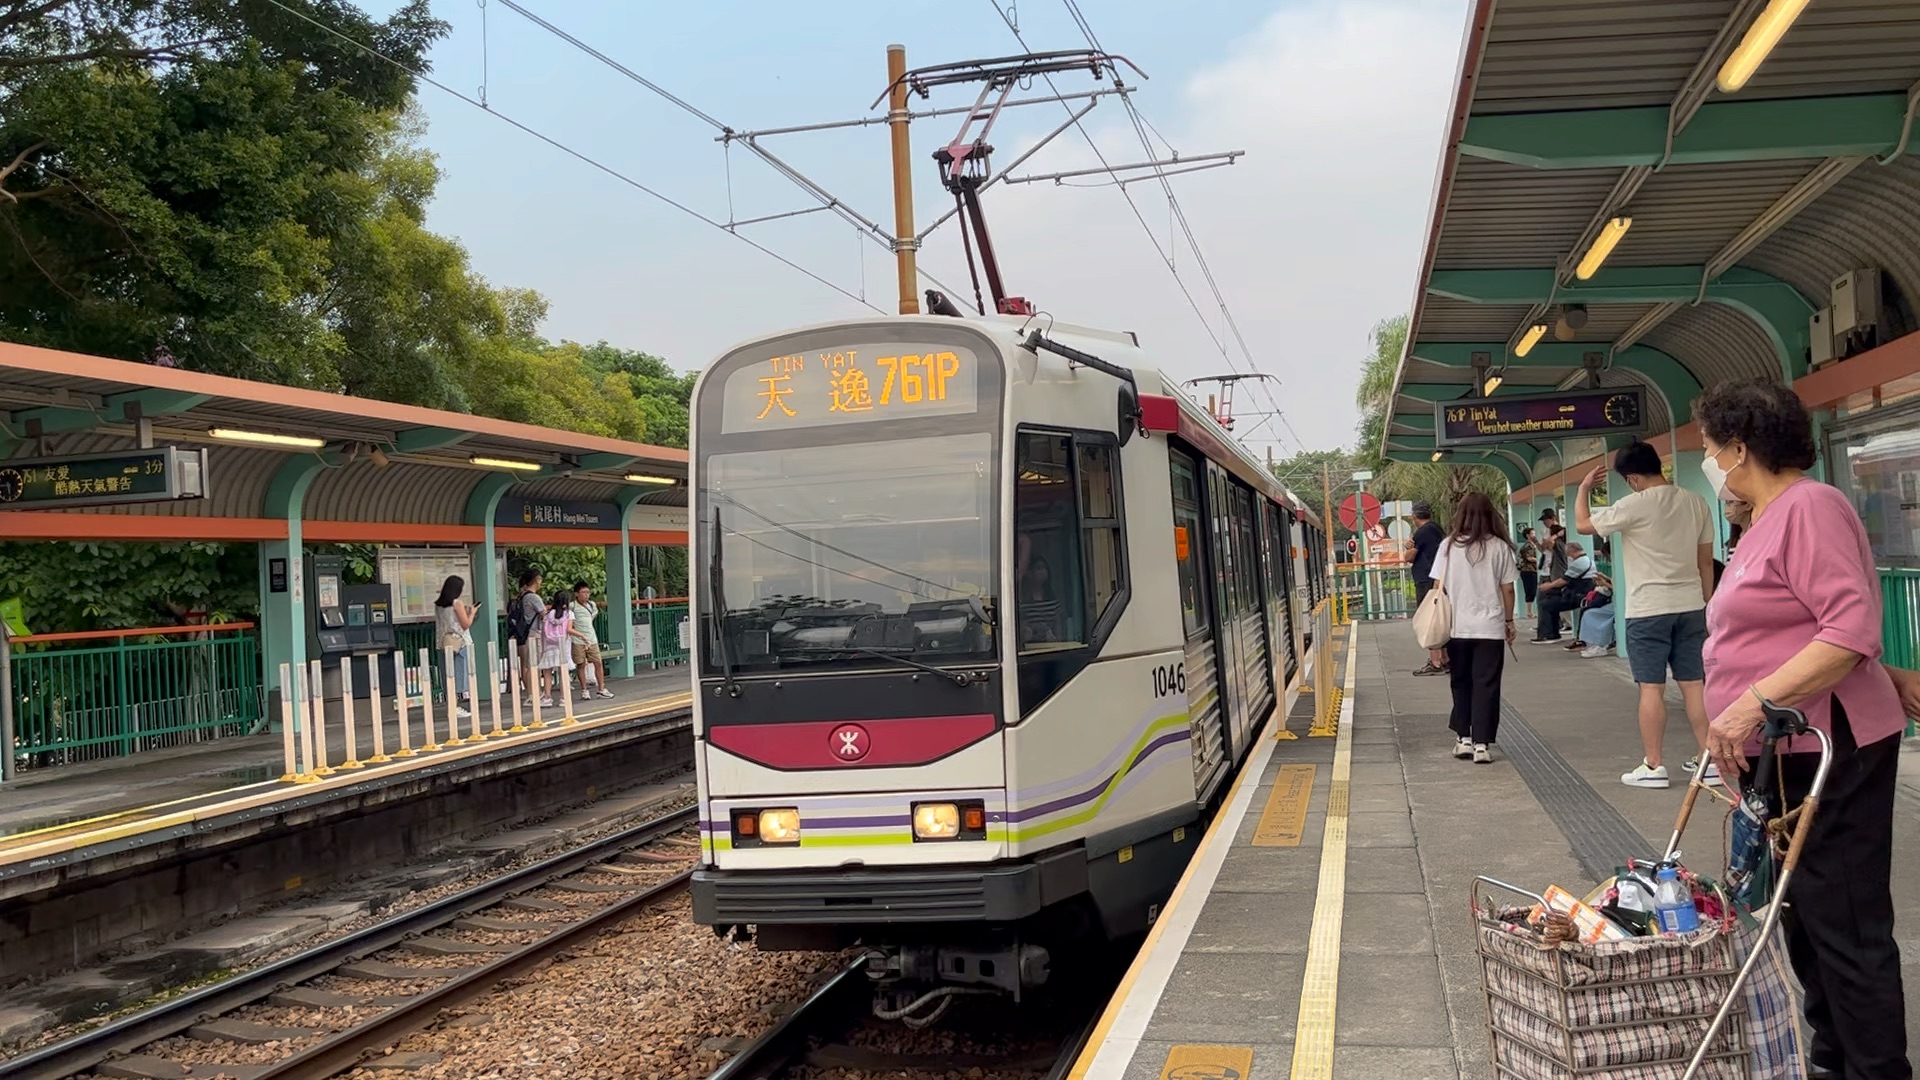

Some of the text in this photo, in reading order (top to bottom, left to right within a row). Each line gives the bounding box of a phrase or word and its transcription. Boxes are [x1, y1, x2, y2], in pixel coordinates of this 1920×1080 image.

[770, 351, 857, 372] TIN YAT
[876, 352, 959, 404] 761P
[1470, 407, 1483, 421] Tin
[1483, 406, 1497, 420] Yat
[1477, 417, 1574, 433] Very hot weather warning
[44, 466, 70, 481] 友愛
[55, 477, 132, 496] 酷熱天氣警告
[534, 505, 561, 522] 坑尾村
[1152, 662, 1186, 698] 1046
